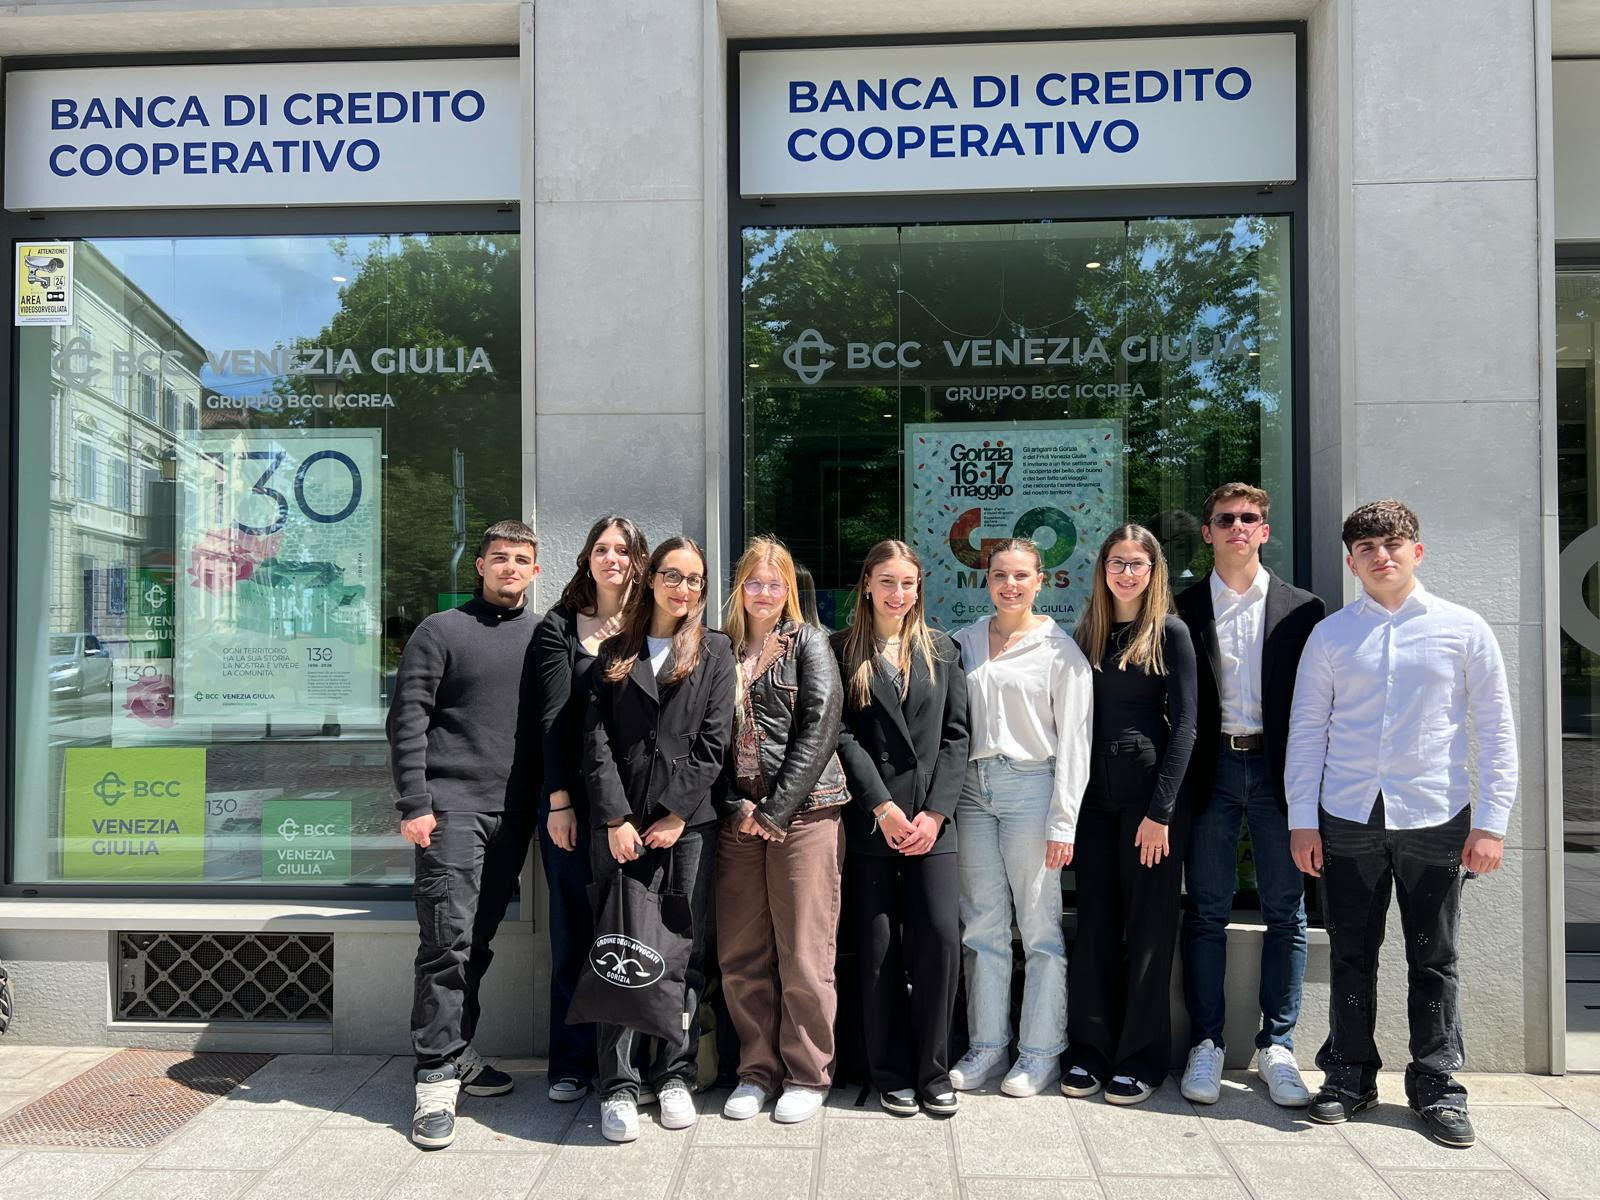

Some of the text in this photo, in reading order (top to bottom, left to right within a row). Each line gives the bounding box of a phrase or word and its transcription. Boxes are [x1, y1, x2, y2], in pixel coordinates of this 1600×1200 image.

[789, 66, 1252, 113] BANCA DI CREDITO
[50, 89, 485, 130] BANCA DI CREDITO
[787, 119, 1139, 162] COOPERATIVO
[49, 138, 381, 177] COOPERATIVO
[55, 277, 63, 286] 24
[20, 295, 41, 304] AREA
[847, 334, 1250, 369] BCC VENEZIA GIULIA
[112, 347, 493, 376] BCC VENEZIA GIULIA
[945, 383, 1146, 401] GRUPPO BCC ICCREA
[206, 393, 395, 409] GRUPPO BCC ICCREA
[950, 440, 1013, 461] Gorizia
[196, 450, 362, 536] 130
[950, 485, 1013, 500] maggio
[969, 602, 989, 613] BCC
[1041, 601, 1075, 613] GIULIA
[306, 647, 333, 661] 130
[121, 665, 157, 681] 130
[133, 780, 181, 797] BCC
[205, 799, 237, 816] 130
[92, 819, 180, 834] VENEZIA
[304, 824, 336, 836] BCC
[92, 840, 160, 856] GIULIA
[277, 849, 335, 861] VENEZIA
[277, 863, 322, 875] GIULIA
[597, 938, 616, 947] ORDINE
[631, 943, 660, 964] AVVOCATI
[606, 971, 630, 984] GORIZIA
